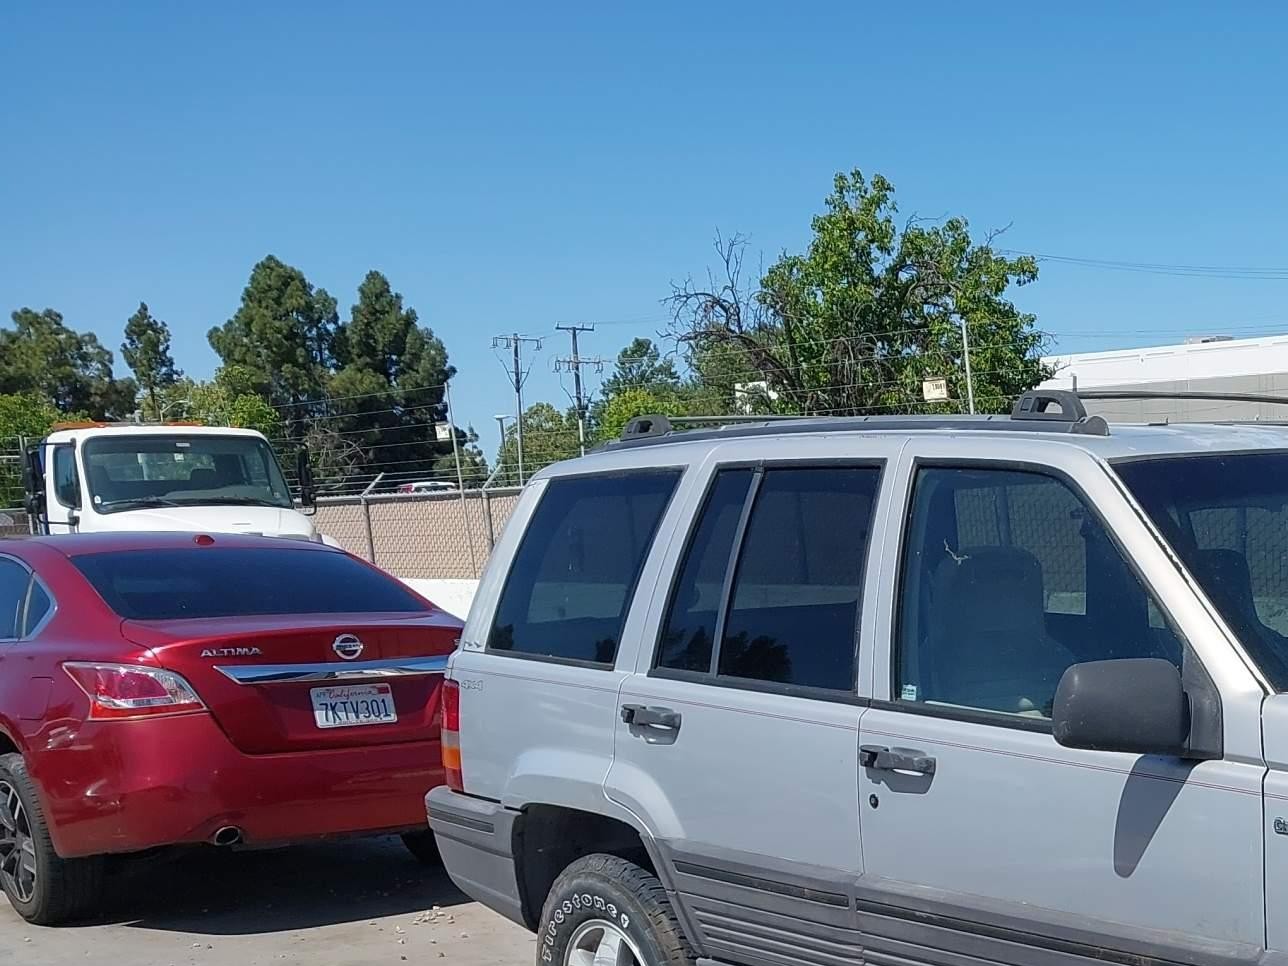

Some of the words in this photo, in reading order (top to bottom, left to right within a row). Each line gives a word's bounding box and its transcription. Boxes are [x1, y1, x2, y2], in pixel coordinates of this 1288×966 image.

[200, 647, 262, 657] ALTIMA
[327, 687, 377, 700] California
[319, 698, 392, 724] 7KTV301
